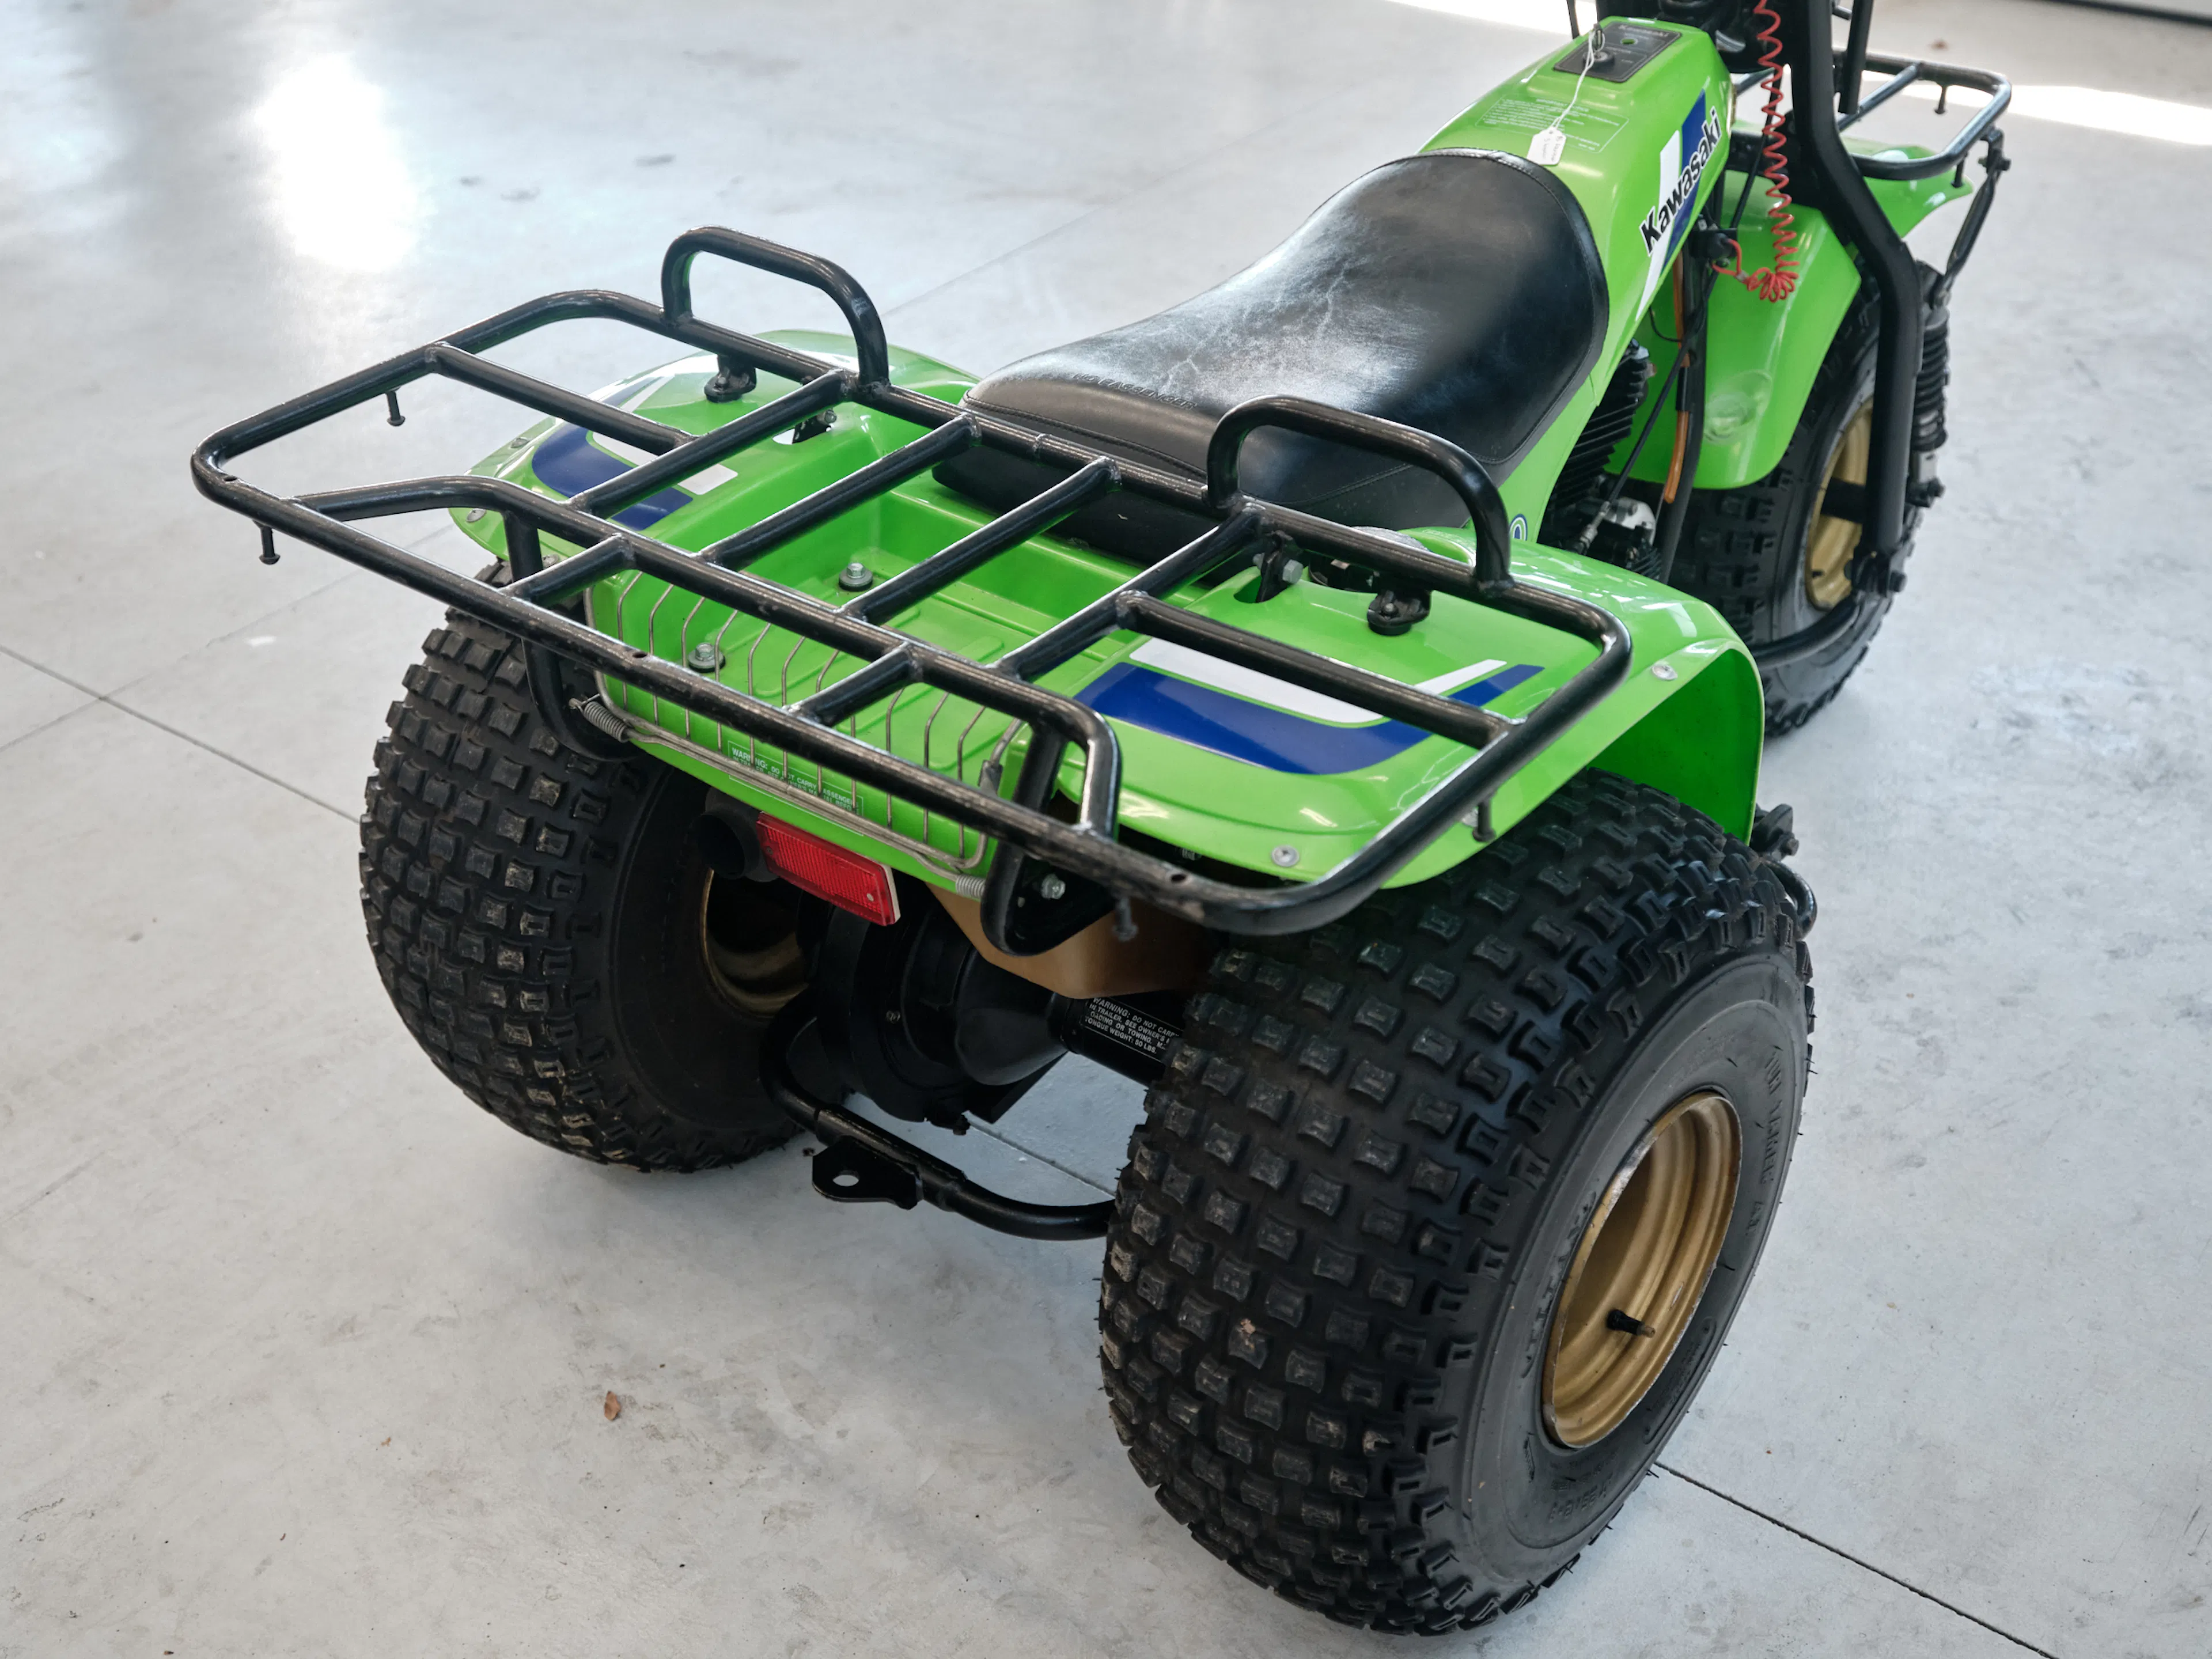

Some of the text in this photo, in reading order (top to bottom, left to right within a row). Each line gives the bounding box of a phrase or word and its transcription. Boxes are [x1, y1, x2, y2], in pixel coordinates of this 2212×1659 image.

[1640, 107, 1721, 256] Kawasaki
[732, 748, 767, 770] WARNG:
[1093, 998, 1130, 1018] WARNING:
[1132, 1015, 1142, 1024] DO
[1143, 1020, 1157, 1030] NOT
[1097, 1006, 1122, 1022] TRAILER.
[1125, 1019, 1138, 1029] SEE
[1138, 1025, 1166, 1041] OWNER'S
[1085, 1016, 1109, 1032] TONGUE
[1109, 1027, 1134, 1043] WEIGHT:
[1135, 1039, 1143, 1047] 50
[1143, 1043, 1157, 1054] LBS.
[1115, 1023, 1125, 1031] OR
[1128, 1028, 1152, 1044] TOWING.
